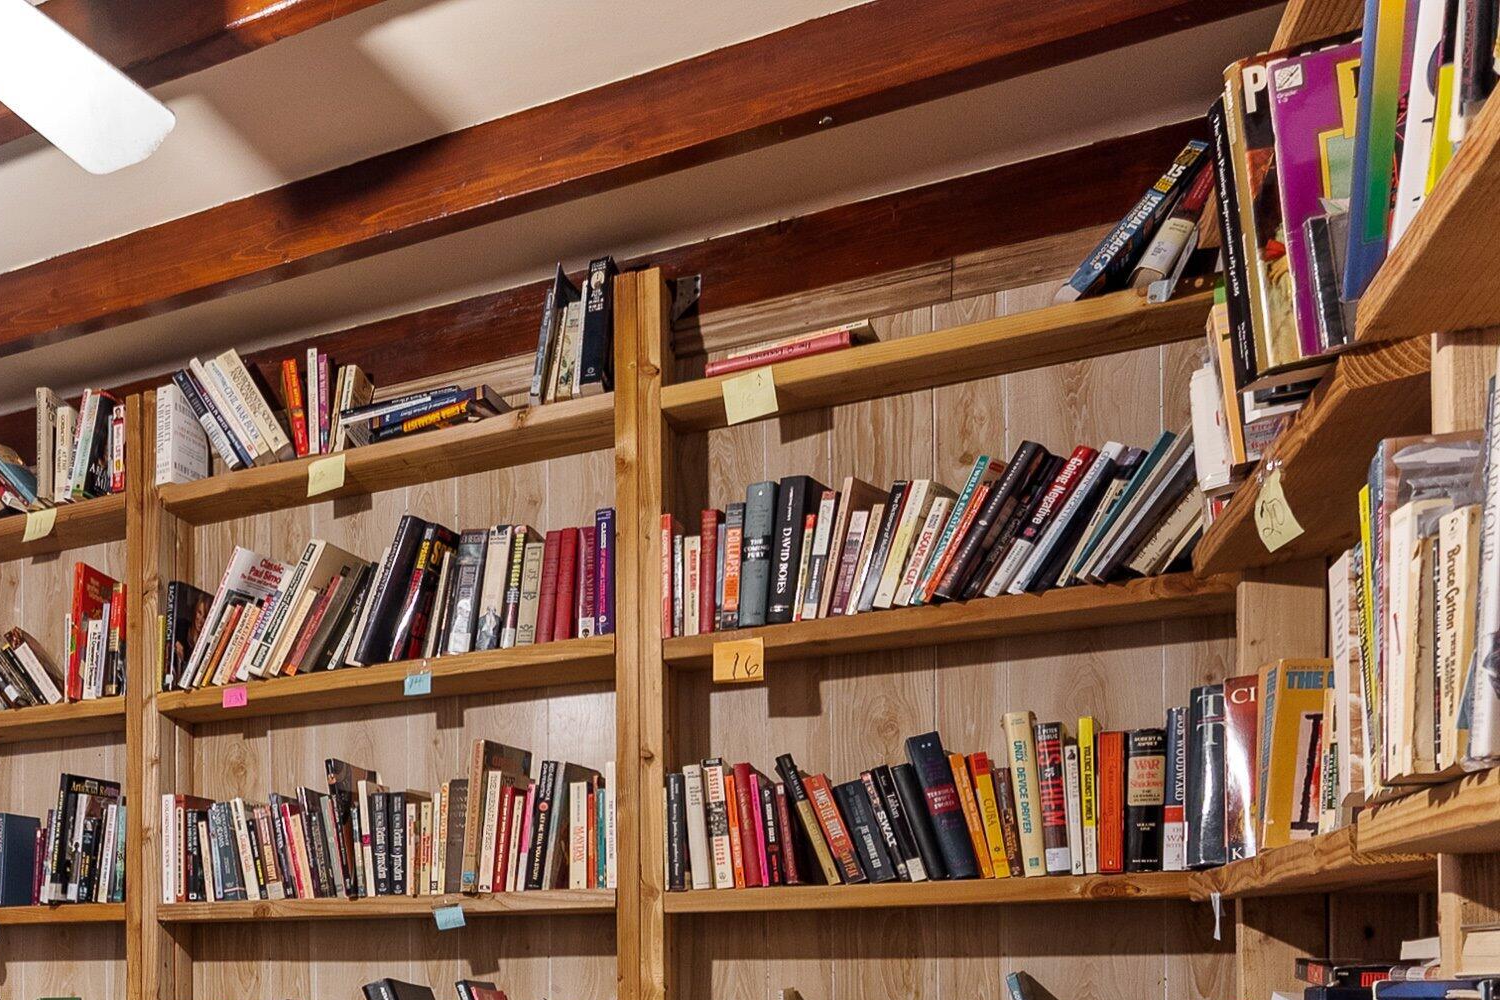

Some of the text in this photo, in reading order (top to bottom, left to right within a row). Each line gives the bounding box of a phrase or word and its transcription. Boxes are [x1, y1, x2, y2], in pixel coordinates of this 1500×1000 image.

[1126, 192, 1161, 232] VISUAL
[1100, 229, 1130, 264] BASIC
[1028, 454, 1084, 527] Going Negative
[726, 529, 741, 576] COLLAPSE
[776, 526, 792, 594] DAVID BOIES
[1443, 544, 1460, 630] Bruce Catton
[732, 652, 759, 680] 16
[1014, 740, 1031, 833] UNIX DEVICE DRIVER
[1135, 760, 1160, 770] WAR
[1175, 740, 1183, 800] WOODWARD
[812, 787, 831, 809] JAMES
[820, 806, 835, 820] LEE
[1040, 776, 1066, 827] THEM
